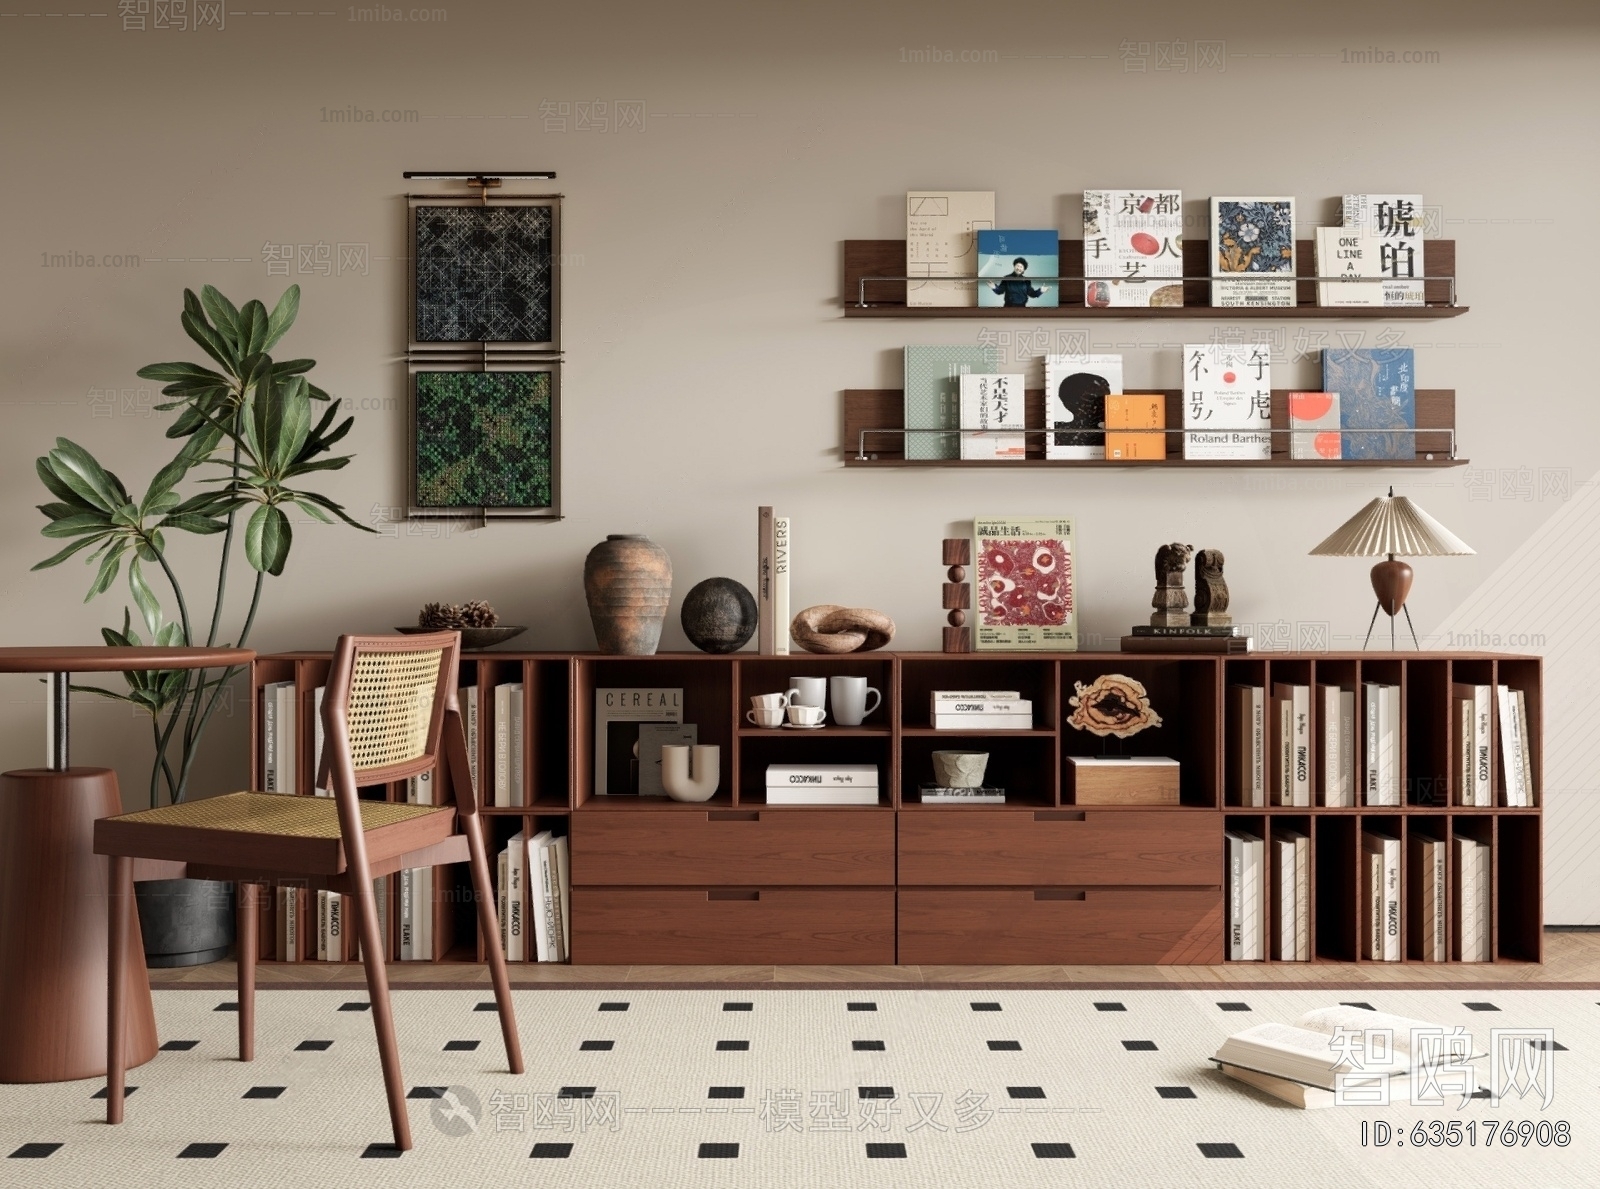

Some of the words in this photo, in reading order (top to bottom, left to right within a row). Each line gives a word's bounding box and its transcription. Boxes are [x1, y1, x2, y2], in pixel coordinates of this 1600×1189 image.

[1118, 193, 1180, 215] 京都
[1085, 237, 1111, 259] 手
[1155, 237, 1181, 259] 人
[1339, 238, 1359, 247] ONE
[1373, 199, 1415, 279] 琥珀
[1337, 250, 1363, 259] LINE
[1347, 262, 1354, 271] A
[1190, 433, 1229, 444] Roland
[1232, 433, 1271, 444] Barthes
[776, 520, 787, 574] RIVERS
[978, 552, 987, 582] MORE
[978, 586, 987, 614] LOVE
[1064, 582, 1072, 614] MORE
[606, 692, 679, 707] CEREAL
[1297, 746, 1307, 782] ПИКАССО
[1479, 746, 1488, 781] ПИКАССО
[789, 775, 822, 784] ПИКАССО
[1369, 769, 1377, 791] FLAKE
[331, 901, 340, 936] ПИКАССО
[511, 901, 520, 936] ПИКАССО
[1388, 901, 1398, 936] ПИКАССО
[1233, 924, 1241, 946] FLAKE
